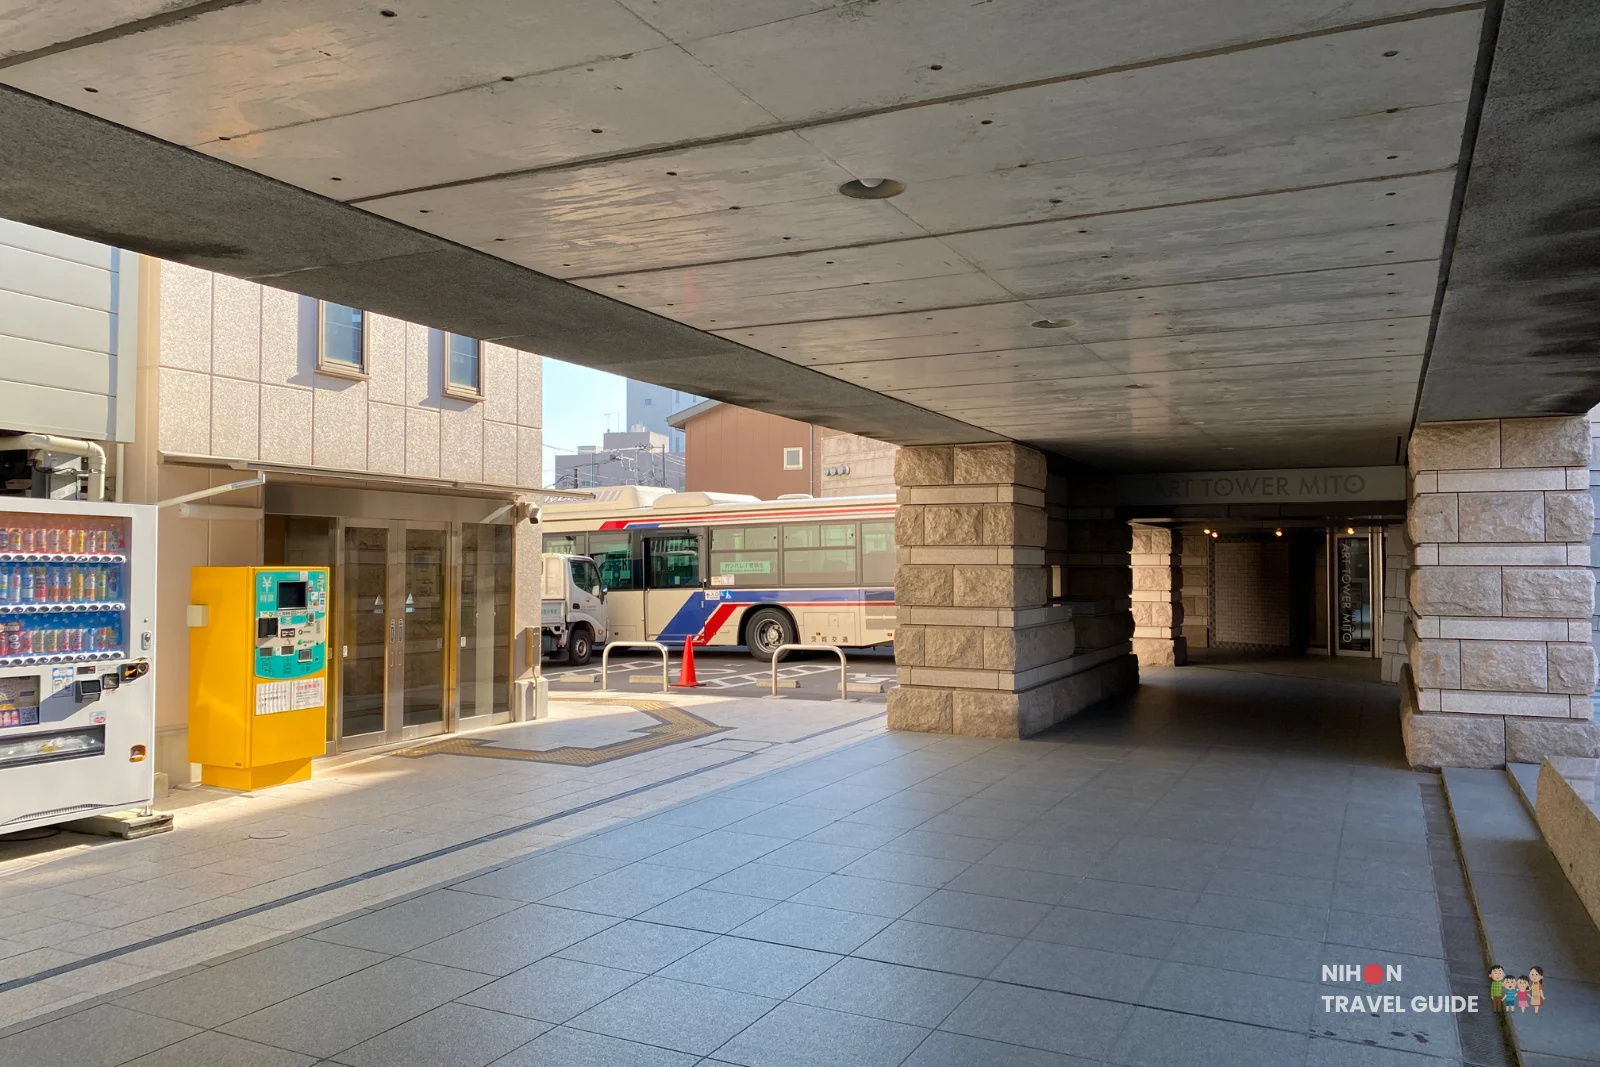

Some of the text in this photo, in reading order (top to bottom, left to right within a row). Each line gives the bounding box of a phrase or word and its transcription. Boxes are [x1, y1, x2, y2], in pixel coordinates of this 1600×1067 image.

[1153, 474, 1365, 497] ART TOWER MITO
[1342, 543, 1352, 643] ART TOWER MITO
